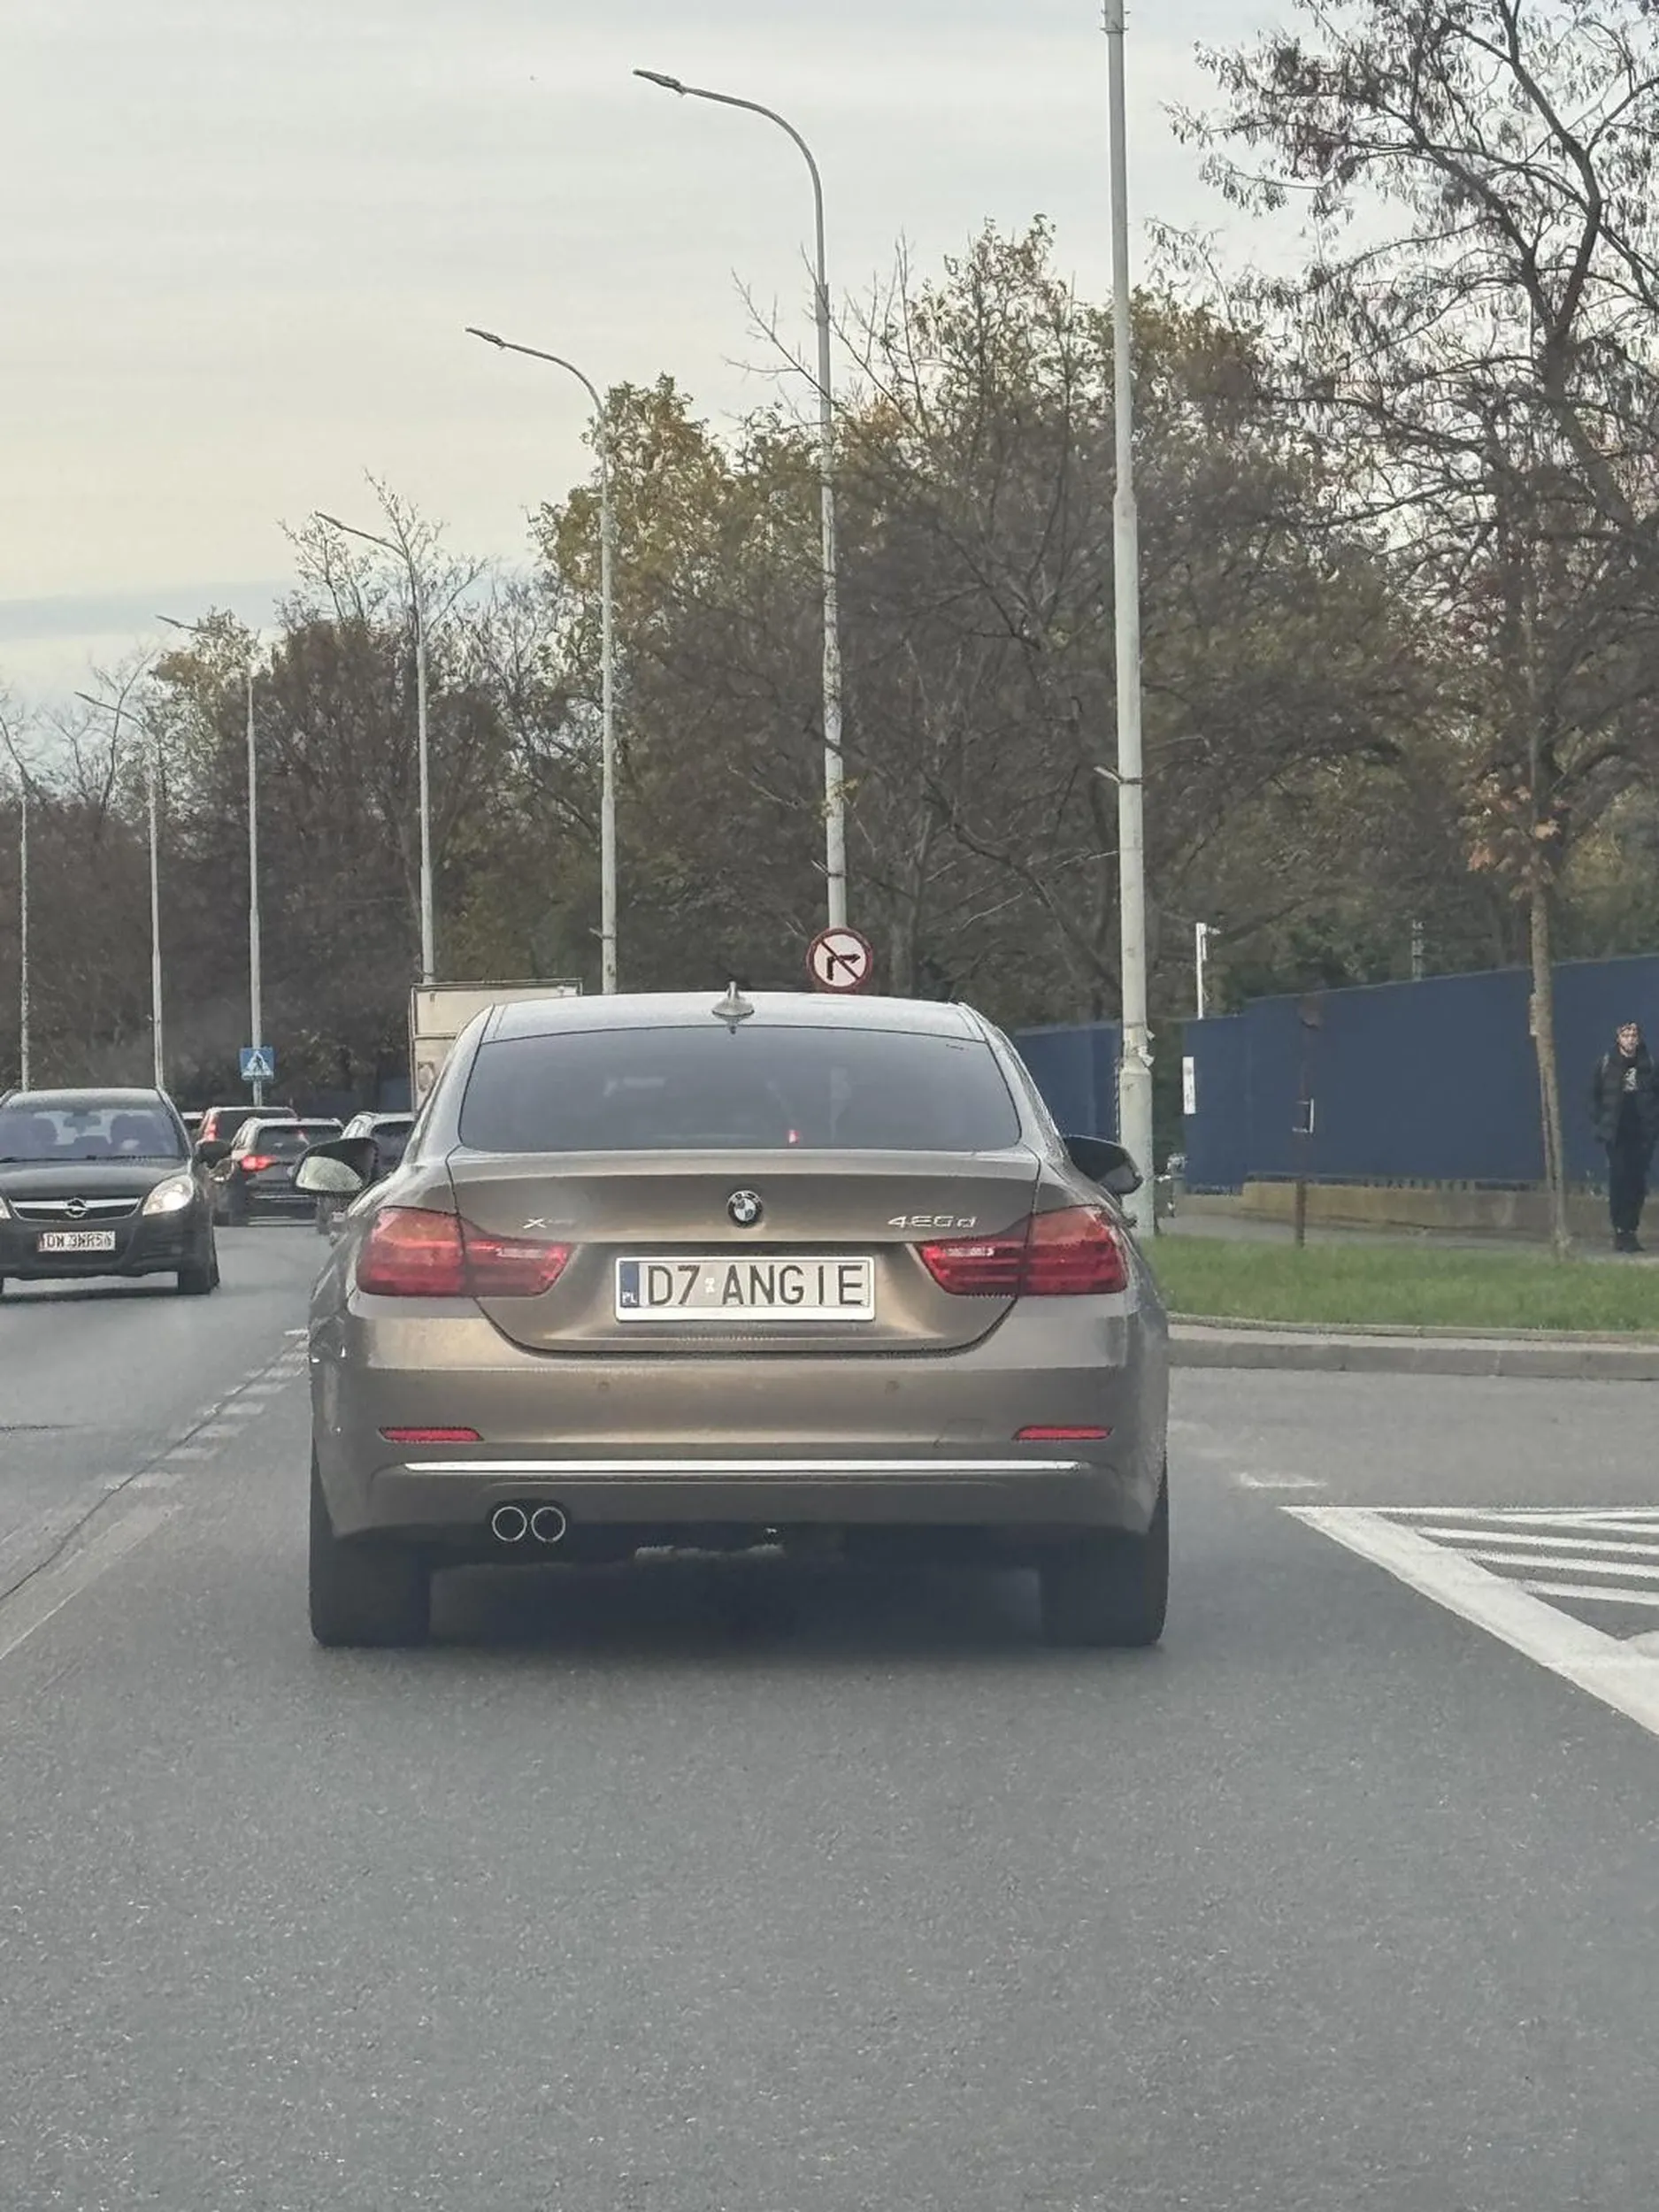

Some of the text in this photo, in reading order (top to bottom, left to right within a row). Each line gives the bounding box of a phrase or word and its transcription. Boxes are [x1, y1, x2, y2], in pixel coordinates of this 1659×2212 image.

[622, 1292, 637, 1303] PL
[648, 1264, 863, 1305] D7 ANGIE
